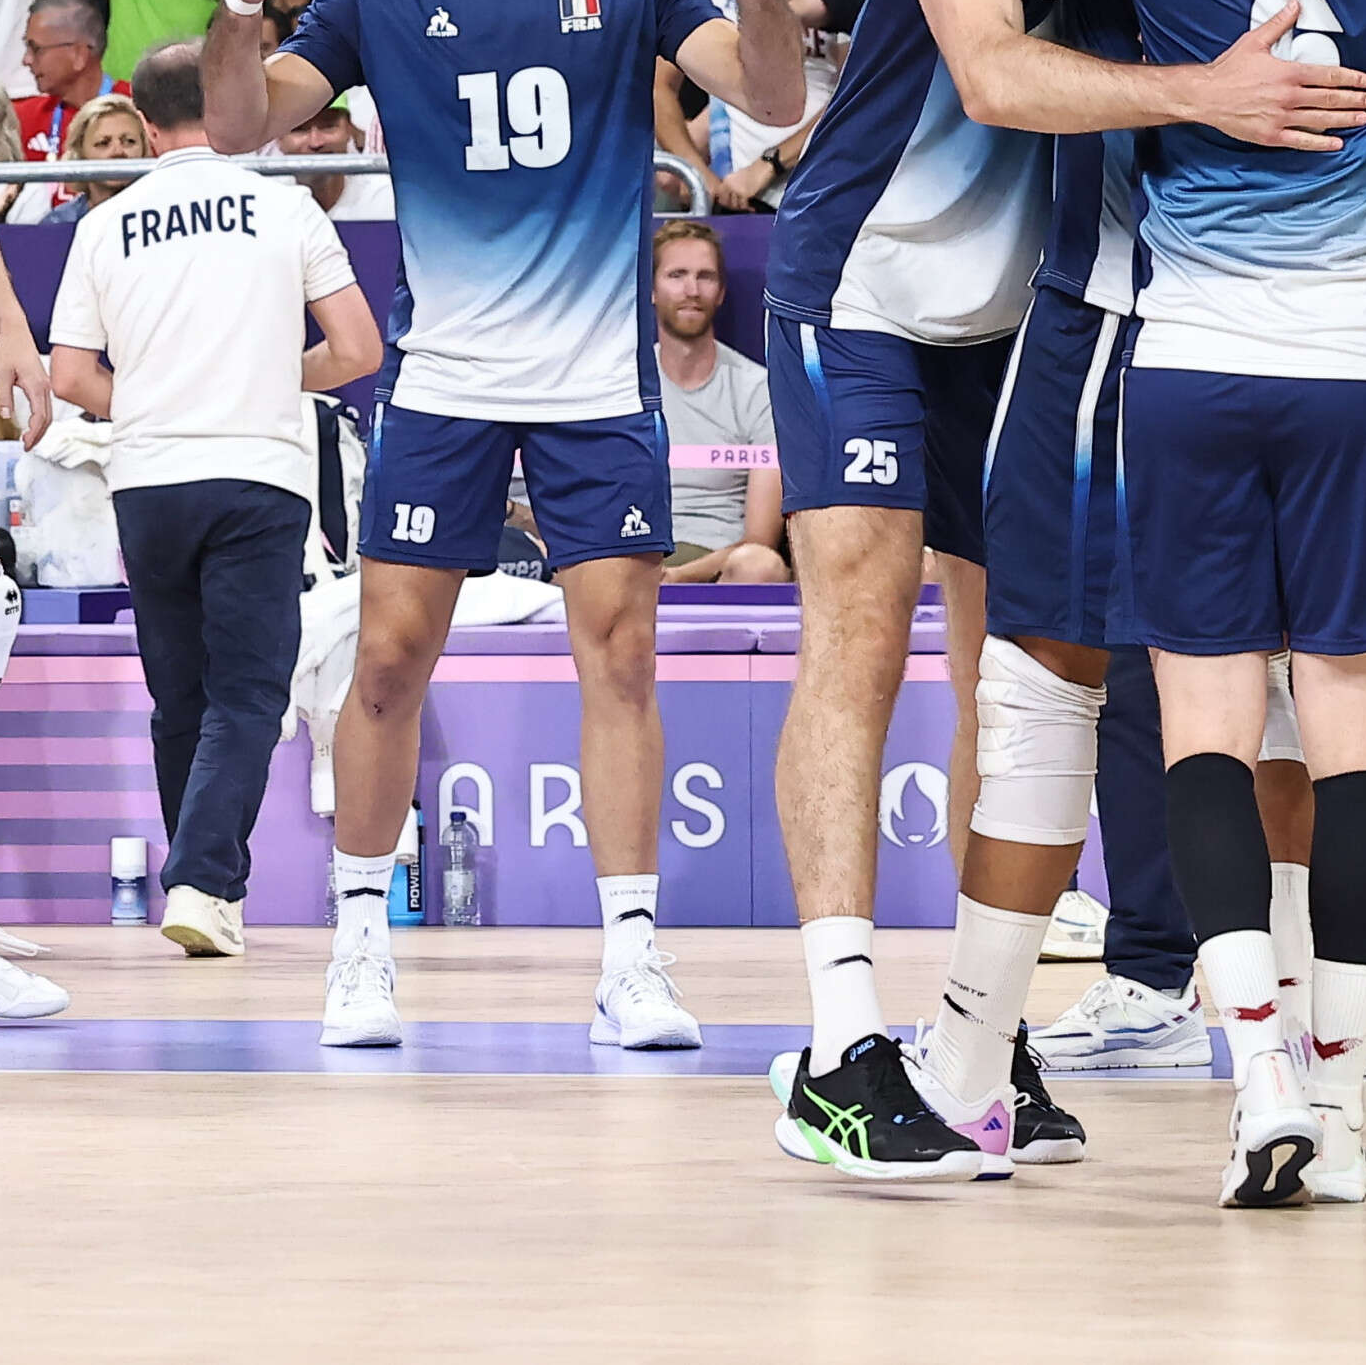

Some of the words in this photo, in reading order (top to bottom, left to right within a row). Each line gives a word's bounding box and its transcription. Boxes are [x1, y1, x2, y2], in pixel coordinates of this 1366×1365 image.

[561, 17, 602, 34] FRA
[457, 67, 573, 172] 19
[122, 196, 257, 258] FRANCE
[711, 449, 771, 464] PARIS
[844, 438, 899, 485] 25
[391, 503, 437, 544] 19
